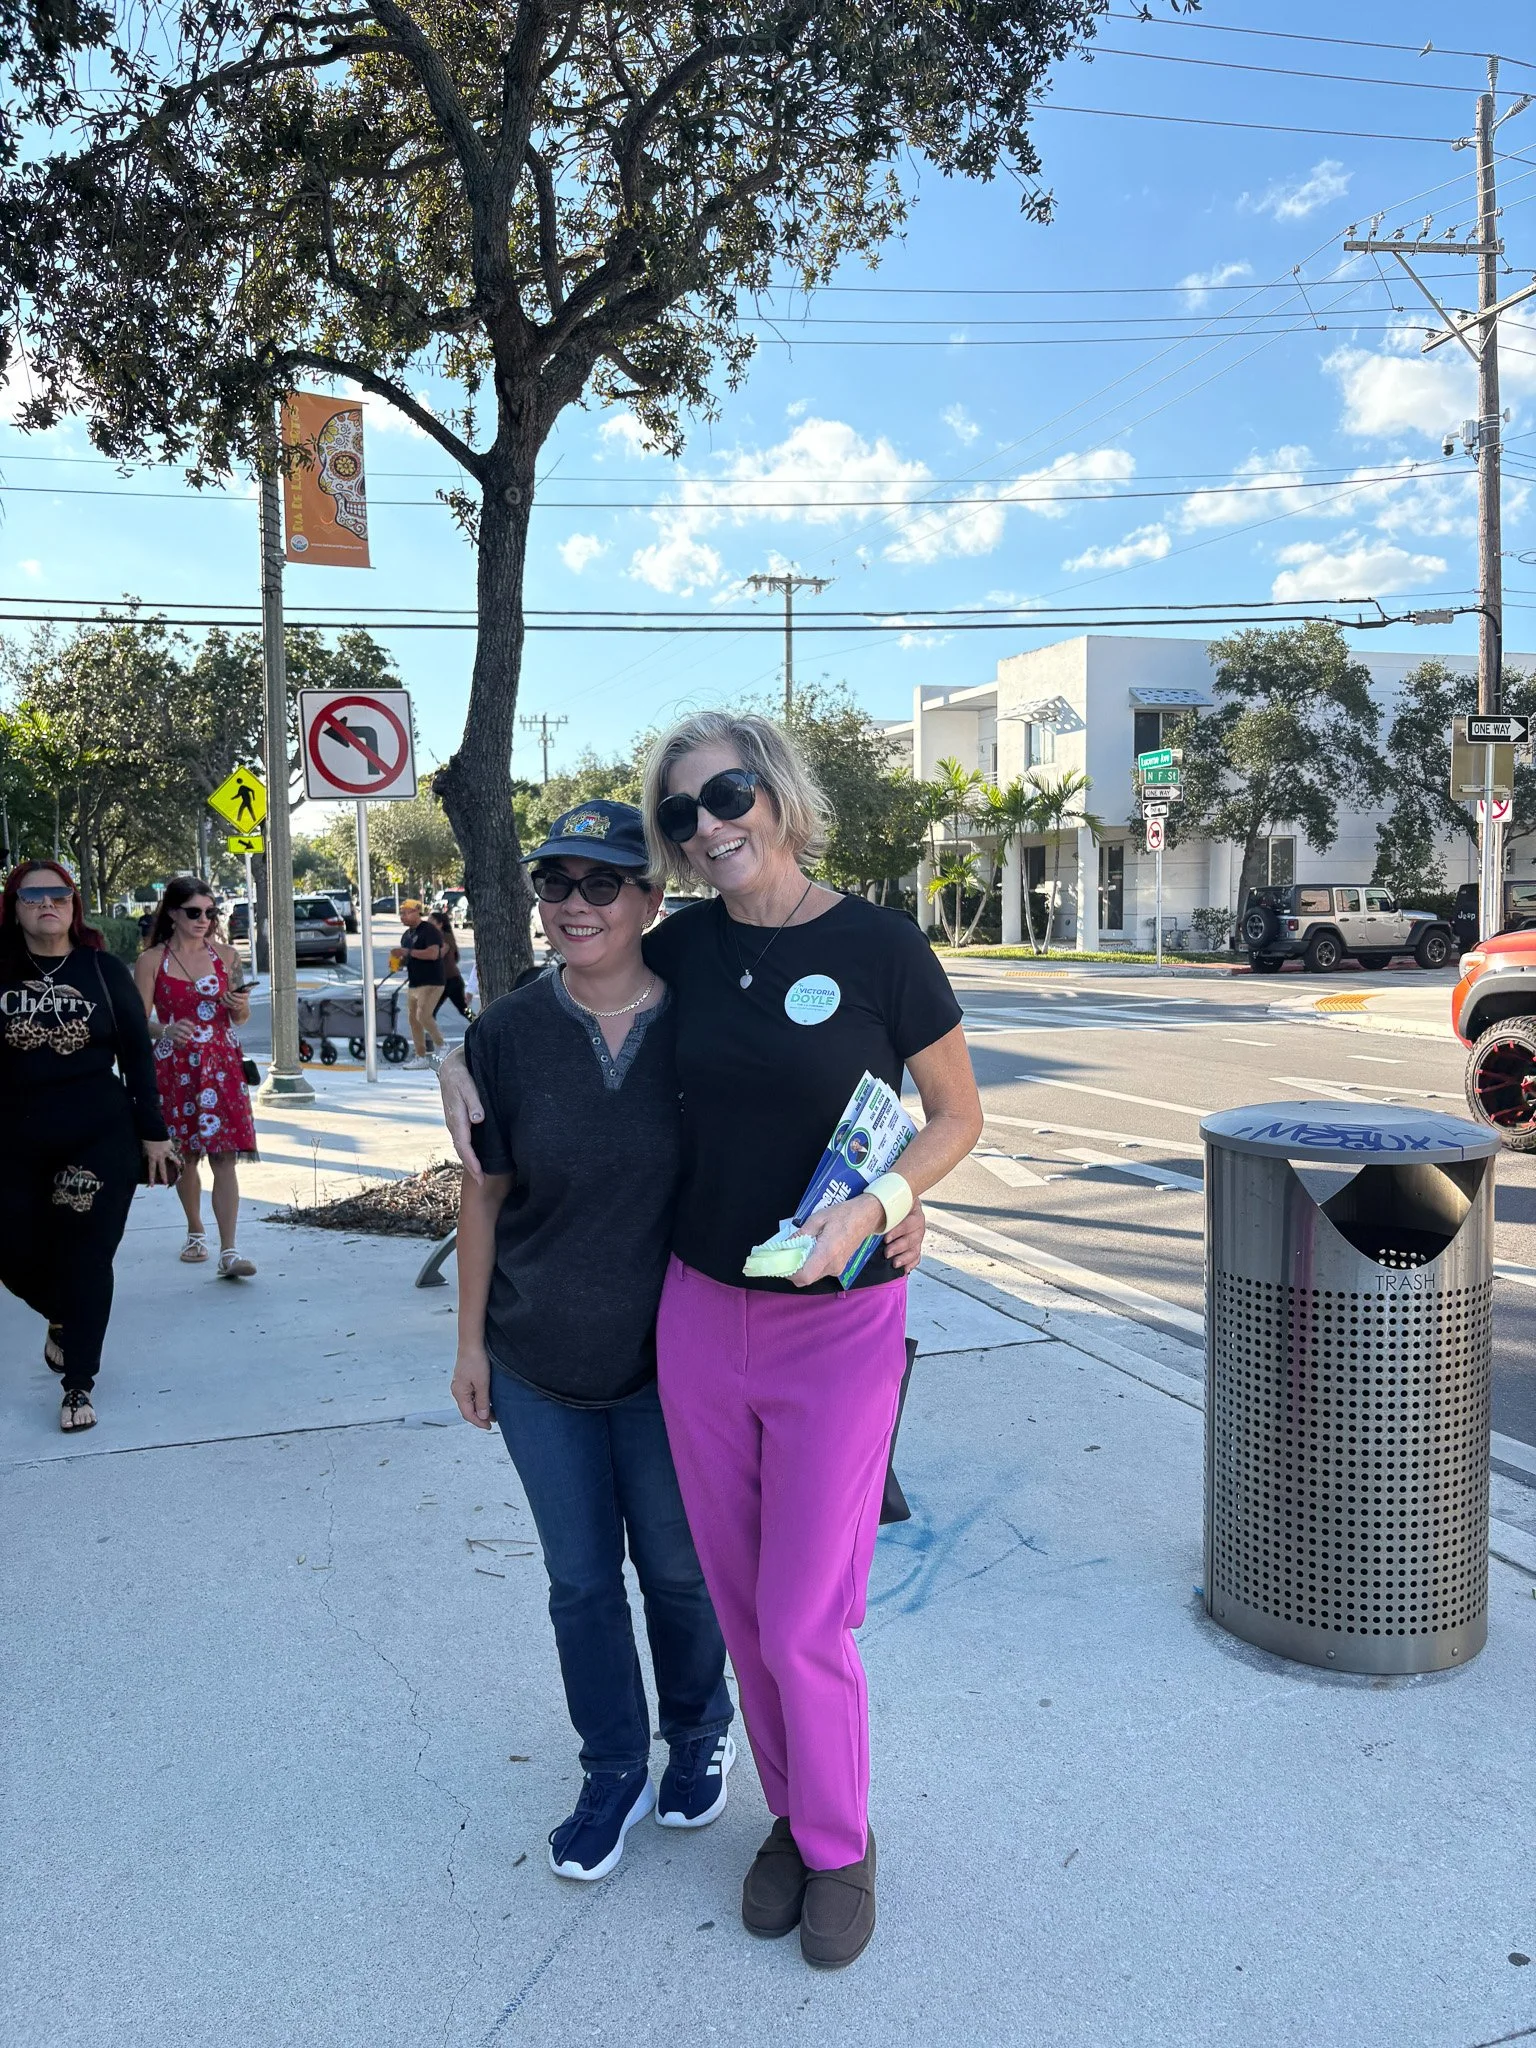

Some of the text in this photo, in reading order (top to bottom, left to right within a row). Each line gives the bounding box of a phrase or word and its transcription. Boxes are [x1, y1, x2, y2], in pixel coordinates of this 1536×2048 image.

[1474, 723, 1511, 735] ONE WAY
[1147, 771, 1177, 781] N F St
[1457, 910, 1476, 921] Jeep
[800, 988, 835, 996] VICTORIA
[790, 994, 835, 1005] DOYLE
[0, 989, 98, 1022] Cherry
[880, 1124, 907, 1172] VICTORIA
[1375, 1273, 1436, 1292] TRASH
